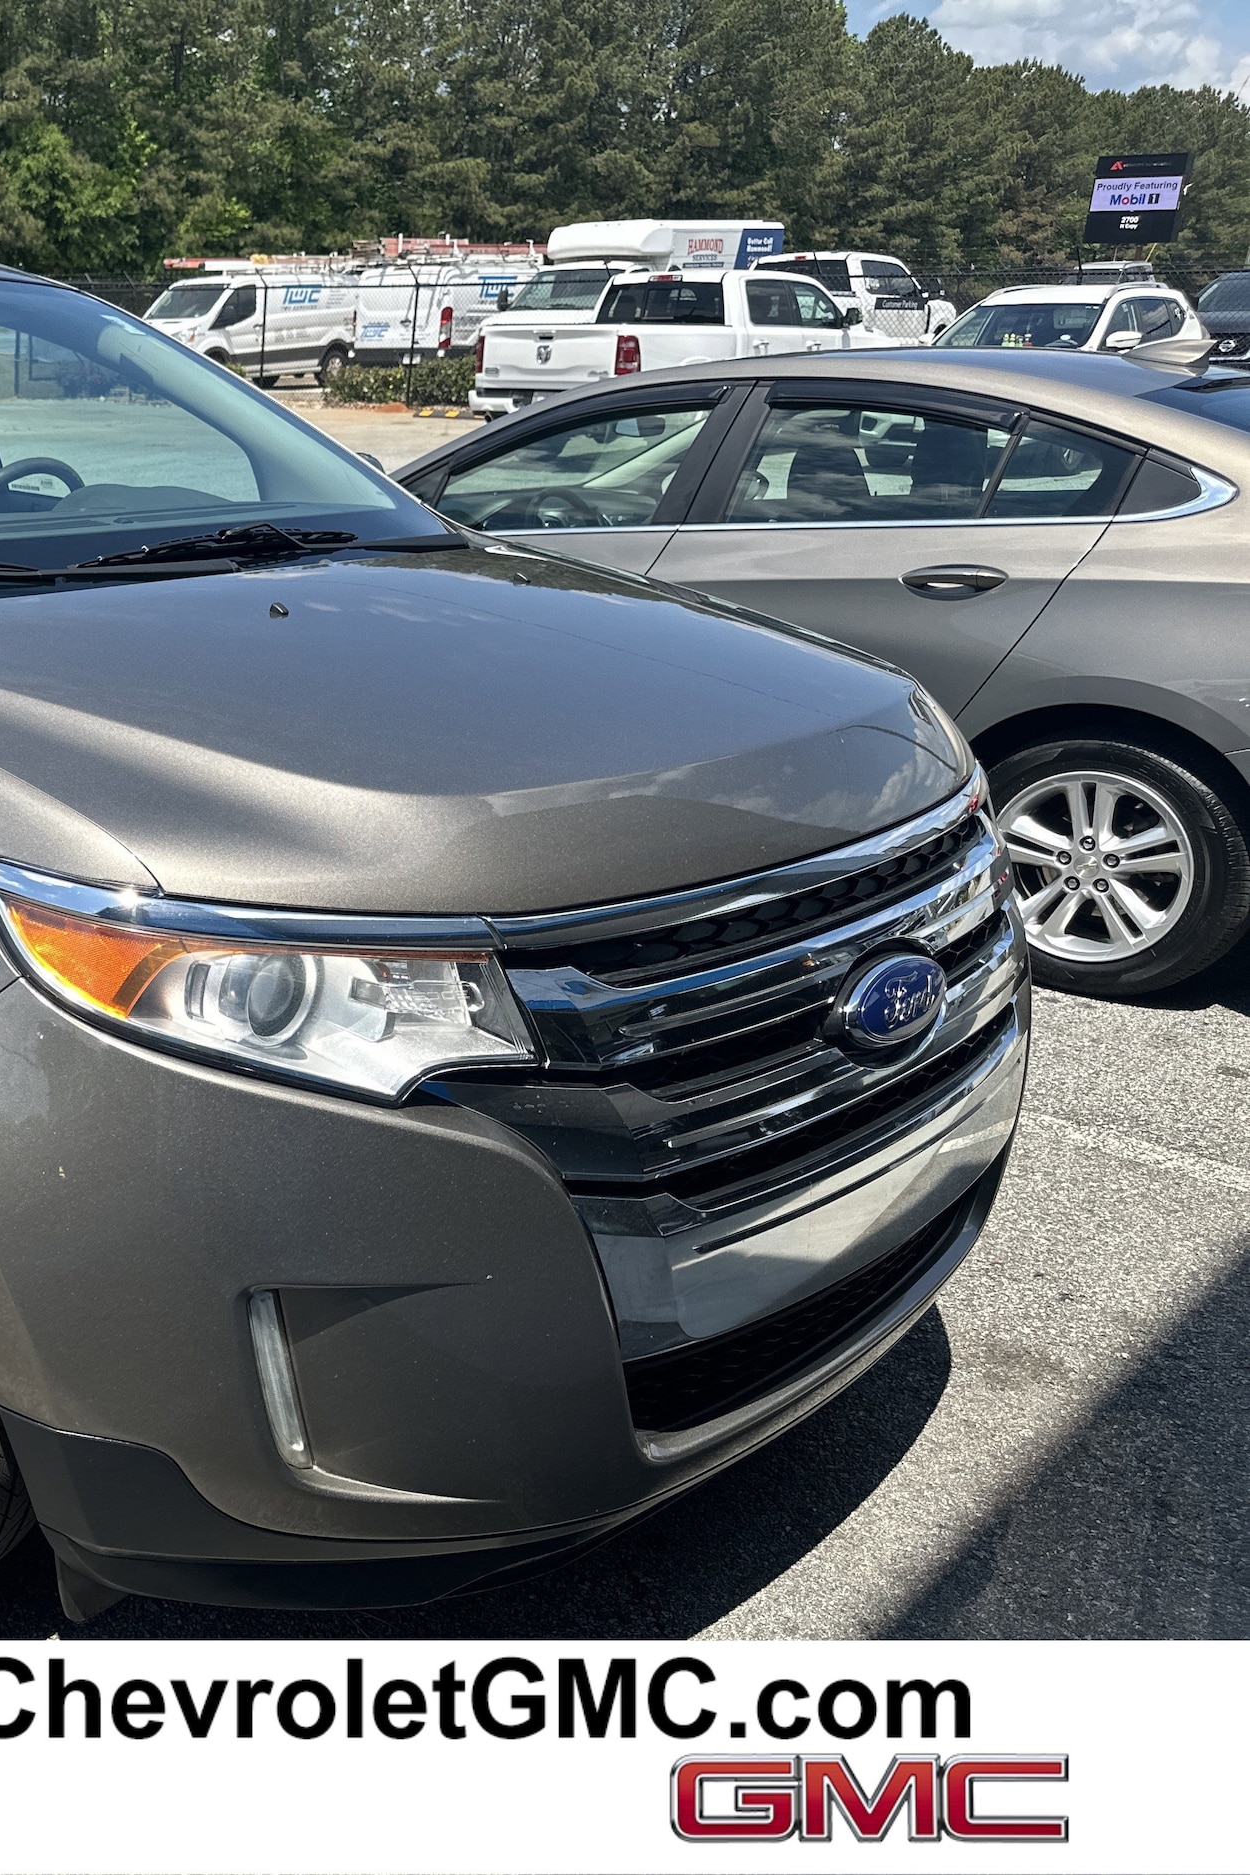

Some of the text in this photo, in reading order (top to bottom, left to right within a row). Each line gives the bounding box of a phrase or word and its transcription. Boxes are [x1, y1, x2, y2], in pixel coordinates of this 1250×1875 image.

[1096, 181, 1178, 192] Proudly Featuring
[1110, 193, 1146, 206] Mobil
[1121, 216, 1140, 224] 2700
[688, 239, 723, 255] HAMMOND
[692, 254, 718, 262] SERVICES
[882, 300, 918, 310] Customer Parking
[884, 970, 936, 1029] Ford
